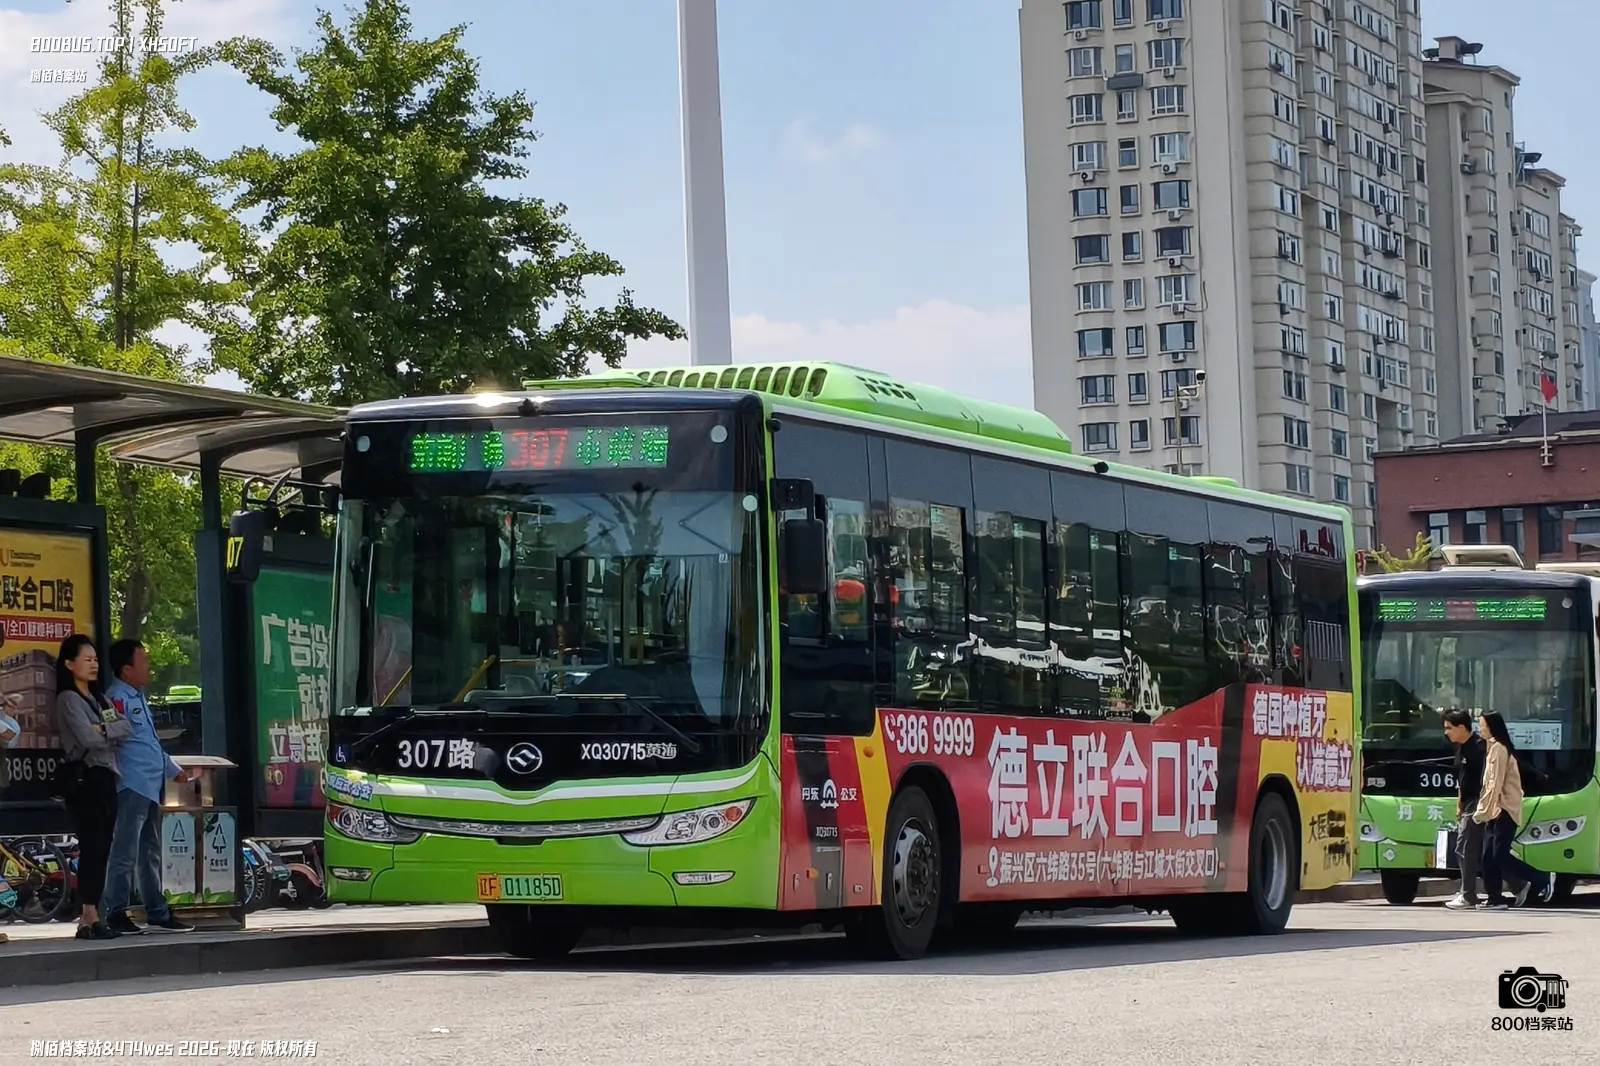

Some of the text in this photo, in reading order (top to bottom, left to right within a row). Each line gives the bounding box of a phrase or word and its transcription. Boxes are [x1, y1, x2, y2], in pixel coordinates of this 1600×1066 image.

[509, 428, 568, 467] 307
[0, 575, 75, 612] 联合口腔
[1252, 690, 1327, 738] 德国种植牙
[398, 738, 476, 769] 307路
[581, 743, 646, 760] XQ30715
[896, 714, 975, 756] 386 9999
[988, 725, 1218, 839] 德立联合口腔
[1420, 773, 1460, 789] 306
[504, 877, 561, 896] 01185D
